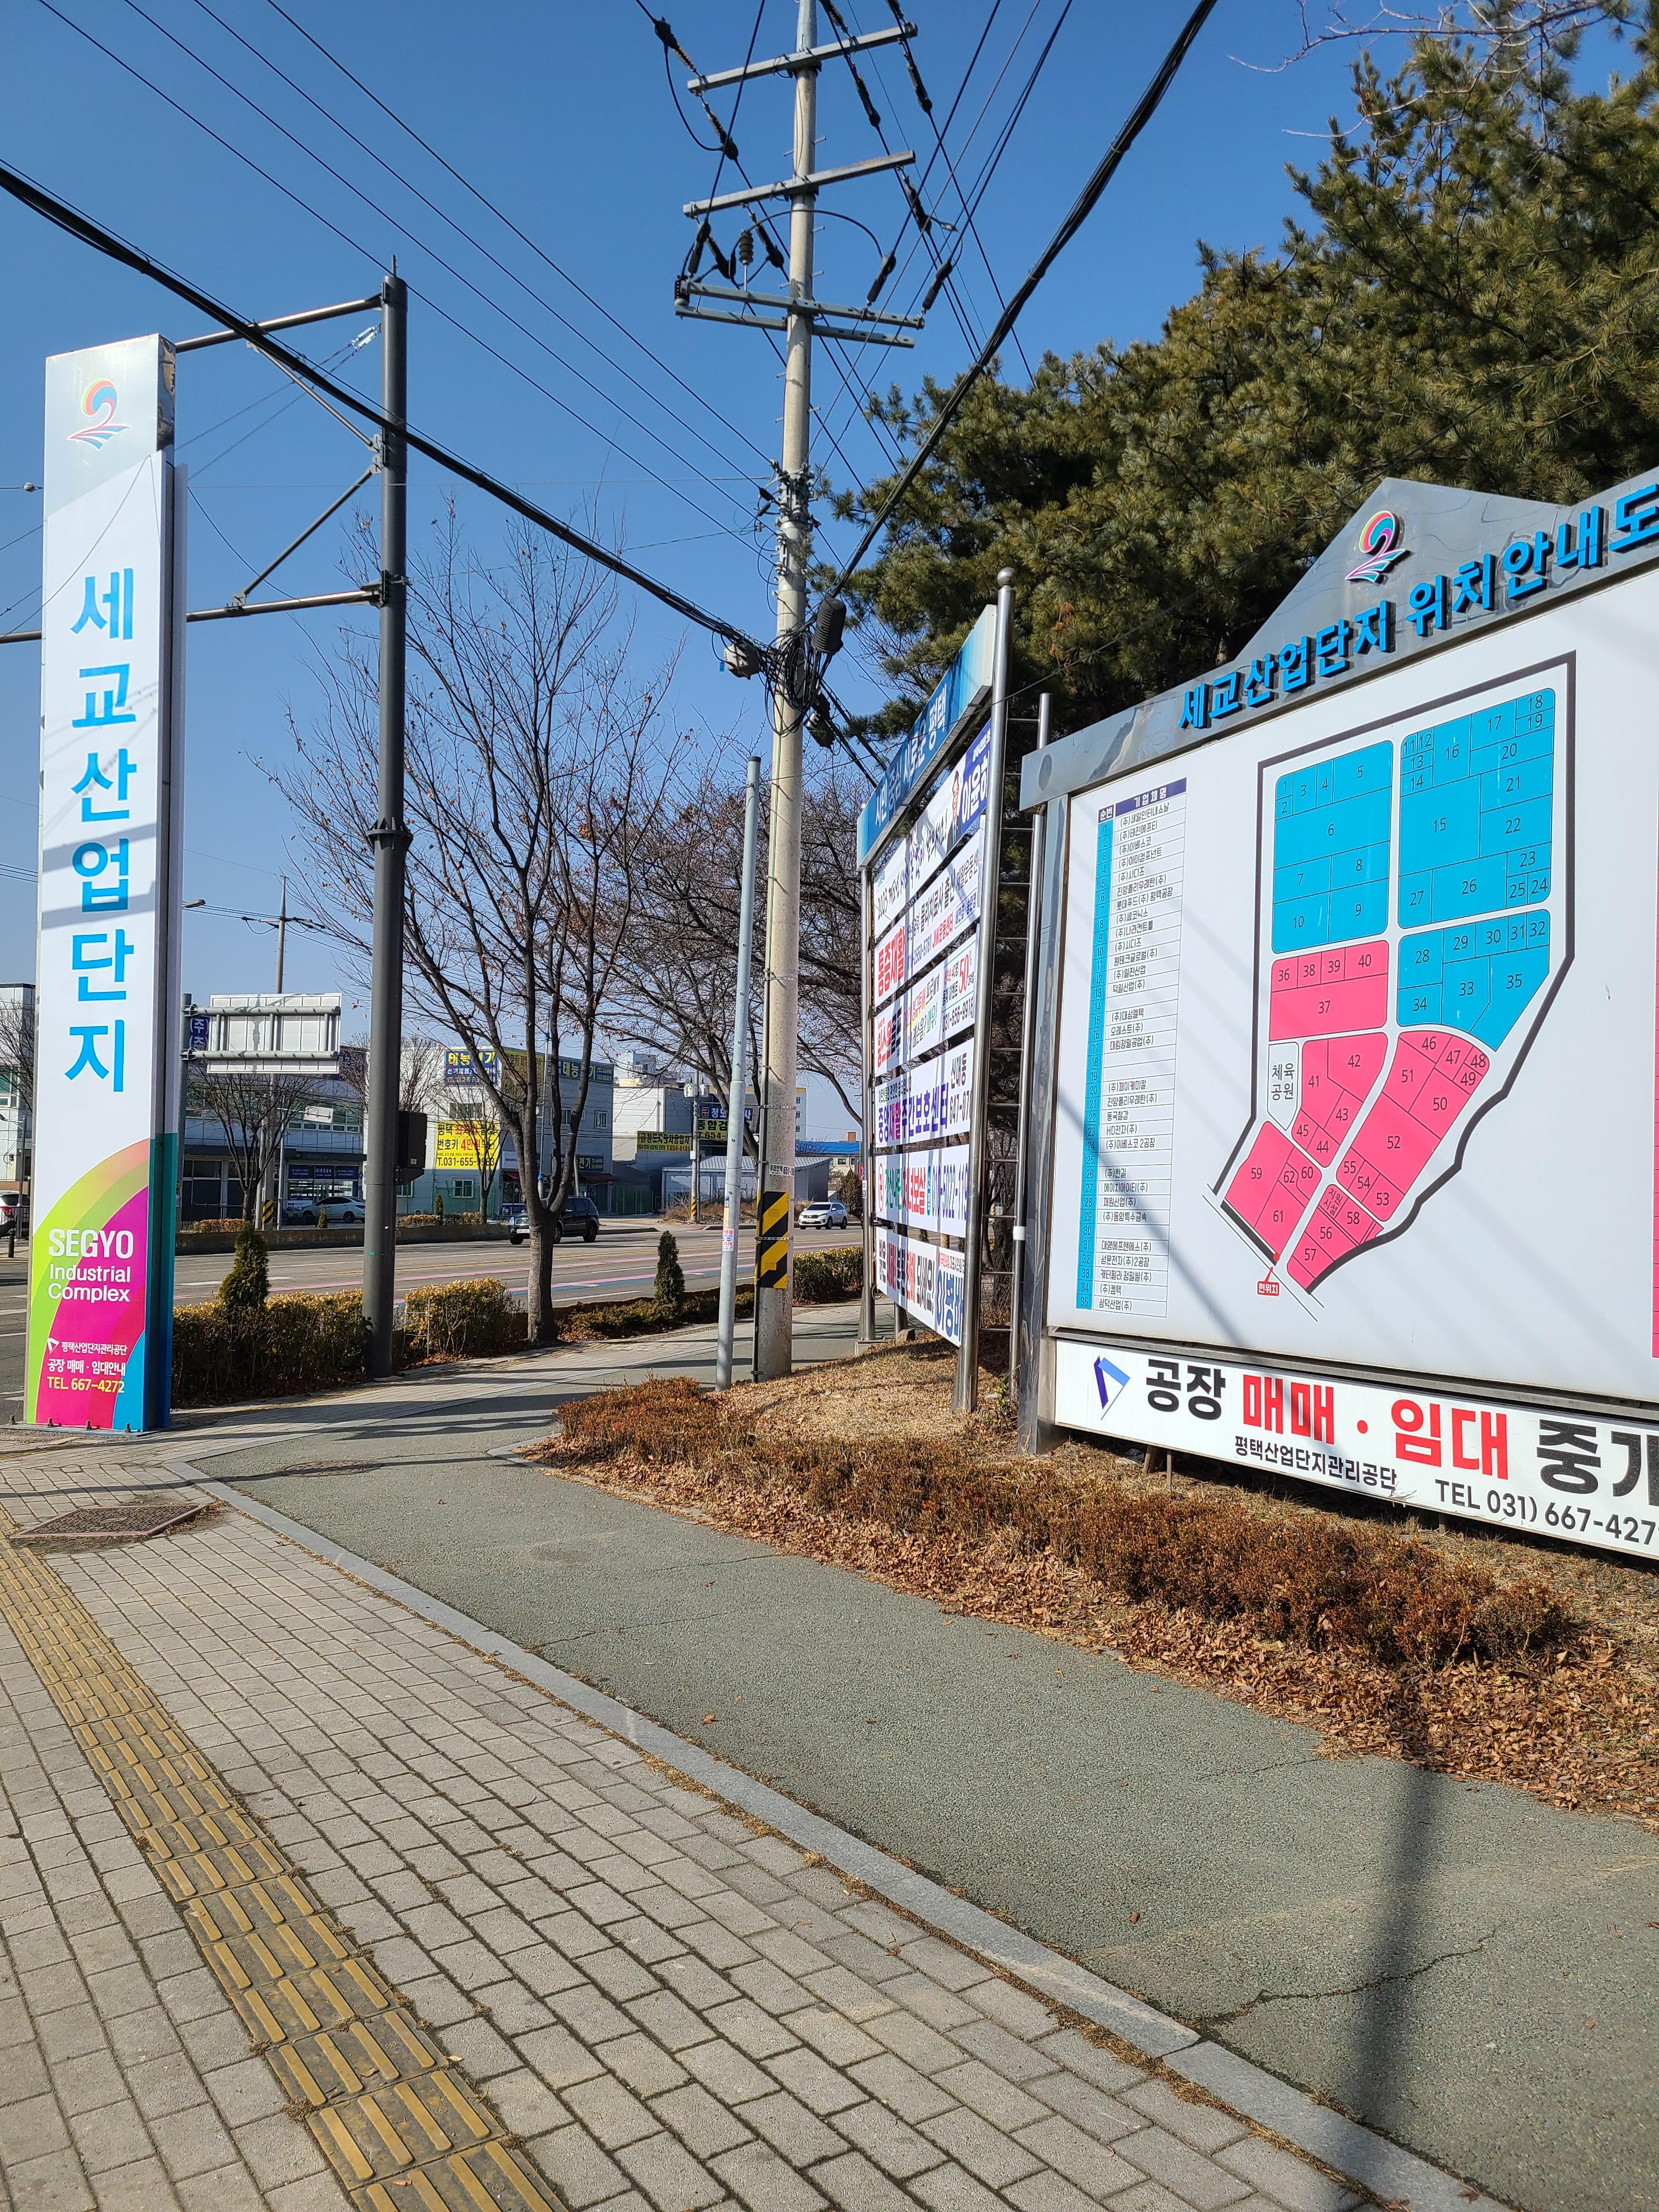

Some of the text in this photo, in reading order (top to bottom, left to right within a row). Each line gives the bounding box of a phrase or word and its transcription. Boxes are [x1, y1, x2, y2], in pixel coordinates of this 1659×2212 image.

[1178, 600, 1393, 729] 세교산업단지
[1527, 695, 1543, 710] 18
[876, 683, 946, 827] 시민 중심 새로운 평택
[1445, 744, 1459, 759] 16
[1502, 743, 1517, 759] 20
[1357, 765, 1363, 778] 5
[1410, 776, 1424, 789] 14
[1300, 785, 1306, 797] 3
[1100, 806, 1113, 820] 순번
[64, 568, 137, 1092] 세교산업단지
[1328, 824, 1334, 837] 6
[1432, 817, 1447, 833] 15
[1505, 819, 1521, 834] 22
[1356, 859, 1362, 871] 8
[1101, 867, 1144, 888] 5 (주)시디즈
[1151, 887, 1172, 901] 평택공장
[1462, 879, 1477, 895] 26
[921, 881, 944, 933] 물리치료사
[944, 868, 955, 910] 출신
[1410, 891, 1424, 906] 27
[1293, 916, 1304, 929] 10
[1530, 922, 1545, 935] 32
[1486, 929, 1501, 944] 30
[1115, 938, 1142, 952] (주)시디즈
[878, 926, 905, 997] 통증재활
[1358, 954, 1371, 967] 40
[1415, 950, 1430, 963] 28
[1114, 965, 1146, 980] (주)일진산업
[1278, 969, 1290, 981] 36
[1113, 979, 1145, 993] 덕일산업(주)
[1506, 974, 1522, 988] 35
[1459, 981, 1474, 996] 33
[1318, 1000, 1330, 1013] 37
[1421, 1037, 1436, 1049] 46
[448, 1053, 495, 1065] 태능기
[1347, 1055, 1361, 1067] 42
[1470, 1054, 1486, 1068] 48
[563, 1062, 595, 1080] 태능기
[951, 1052, 967, 1089] 신대동
[1272, 1063, 1295, 1080] 체육
[1401, 1070, 1414, 1082] 51
[1090, 1086, 1097, 1094] 20
[1271, 1084, 1294, 1100] 공원
[1432, 1097, 1448, 1110] 50
[1336, 1108, 1348, 1121] 43
[1107, 1124, 1137, 1136] HD전자(주)
[1140, 1138, 1155, 1148] 2공장
[1387, 1136, 1401, 1149] 52
[1105, 1169, 1126, 1178] (주)한길
[1251, 1168, 1262, 1180] 59
[1328, 1188, 1342, 1204] 지원
[1376, 1193, 1389, 1206] 53
[1084, 1211, 1092, 1221] 29
[1273, 1211, 1284, 1223] 61
[1347, 1212, 1359, 1224] 58
[1320, 1227, 1332, 1239] 56
[49, 1228, 133, 1259] SEGYO
[879, 1239, 886, 1284] 밝은
[50, 1264, 131, 1282] Industrial
[48, 1283, 130, 1303] Complex
[1259, 1283, 1278, 1294] 현위치
[1080, 1297, 1132, 1311] 35 삼덕산업(주)
[61, 1342, 127, 1356] 평택산업단지관리공단
[48, 1359, 126, 1376] 공장 매매 임대안내
[71, 1378, 125, 1393] 667-4272
[1146, 1358, 1226, 1420] 공장
[1243, 1374, 1335, 1445] 매매
[1391, 1398, 1509, 1480] 임대
[1234, 1436, 1398, 1490] 평택산업단지관리공단
[1435, 1479, 1659, 1545] TEL 031) 667-427
